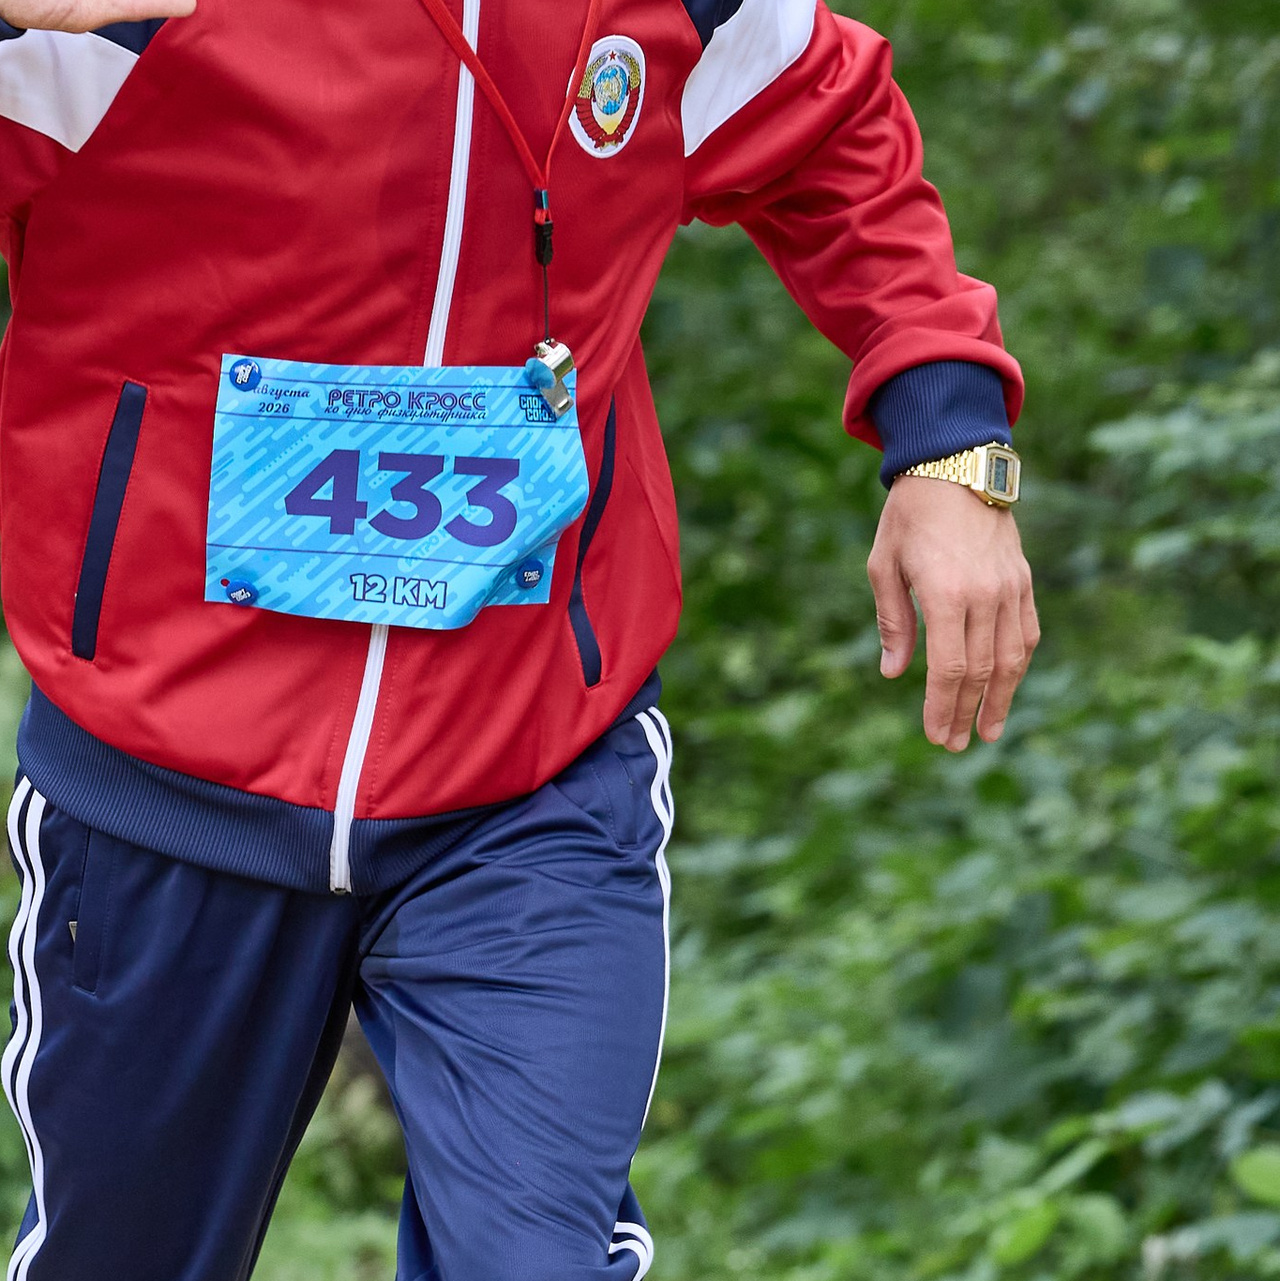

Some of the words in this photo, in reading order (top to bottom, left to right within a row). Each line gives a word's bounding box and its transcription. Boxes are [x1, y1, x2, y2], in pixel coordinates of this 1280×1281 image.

[258, 402, 290, 414] 2026
[328, 388, 402, 409] РЕТРО
[407, 390, 487, 411] КРОСС
[324, 405, 340, 414] ко
[345, 407, 373, 419] дню
[284, 449, 520, 548] 433
[349, 572, 387, 604] 12
[392, 576, 448, 610] КМ
